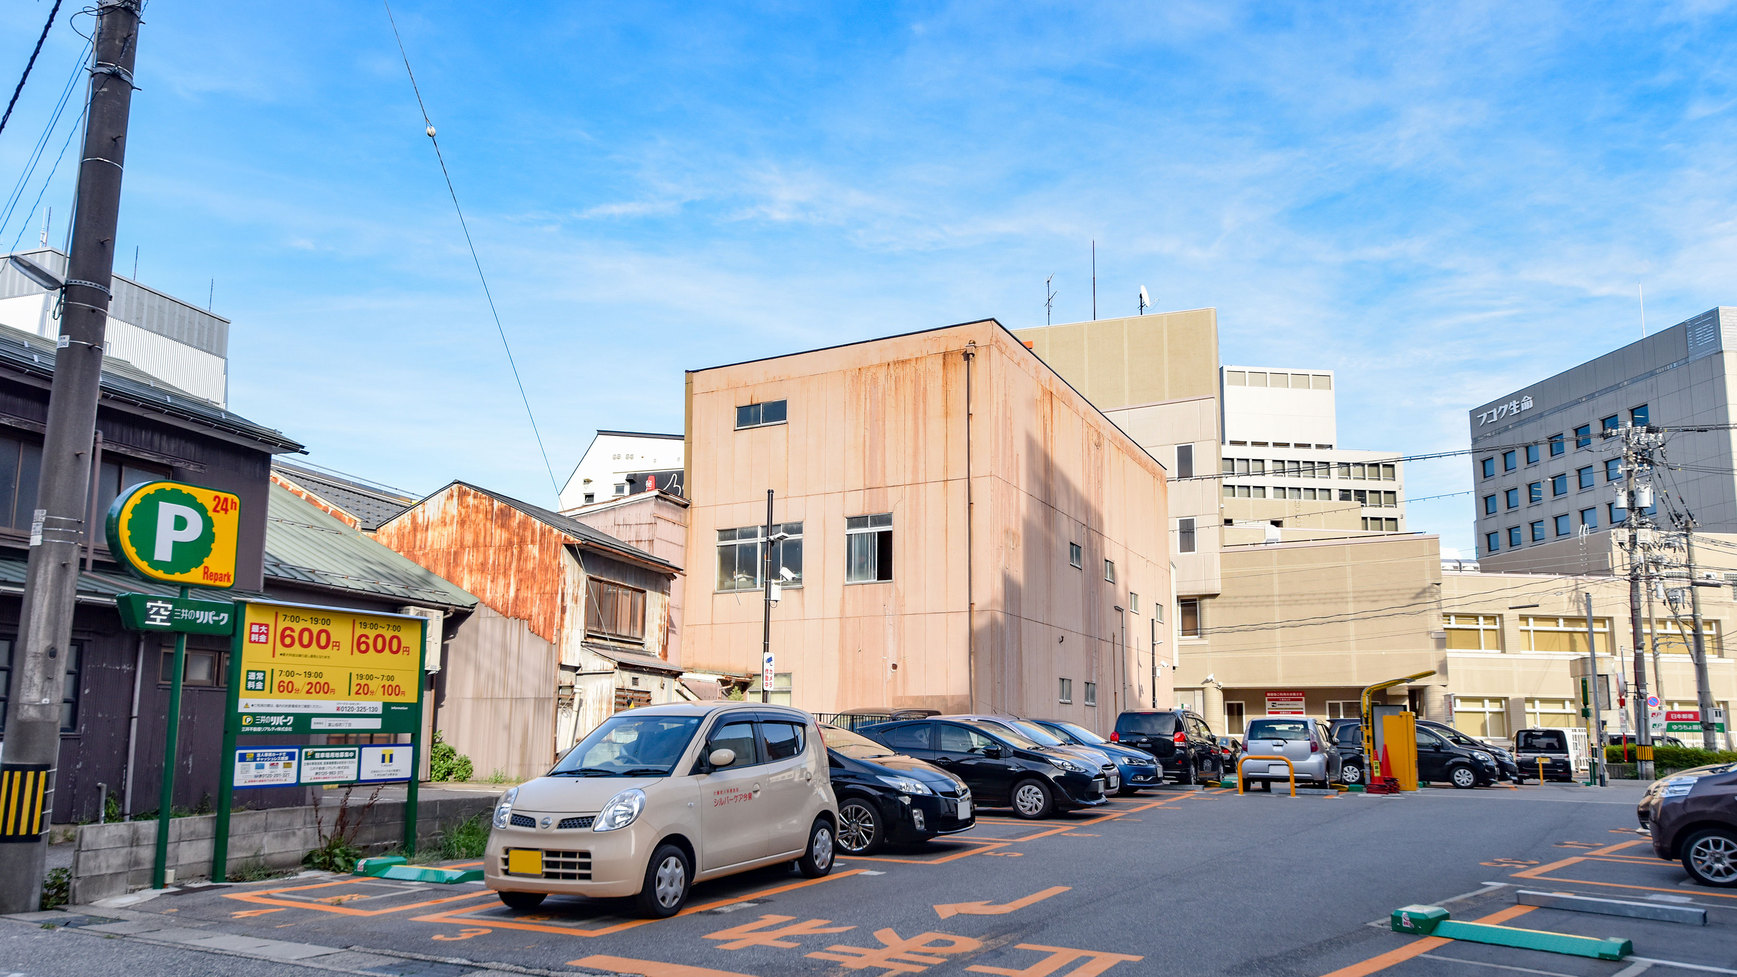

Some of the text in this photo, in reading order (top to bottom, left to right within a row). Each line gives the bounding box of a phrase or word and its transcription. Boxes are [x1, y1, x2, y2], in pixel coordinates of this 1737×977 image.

[1476, 395, 1534, 427] フコク生命
[212, 495, 238, 515] 24h
[153, 501, 203, 562] P
[202, 565, 232, 584] Repark
[144, 600, 173, 627] 空
[173, 608, 229, 626] 三井のリパーク
[250, 633, 267, 643] 料金
[251, 624, 268, 634] 最大
[279, 626, 341, 651] 600円
[356, 633, 410, 656] 600円
[247, 671, 264, 680] 通常
[247, 681, 264, 690] 料金
[255, 715, 294, 726] 三井のリパーク
[431, 928, 493, 941] 3
